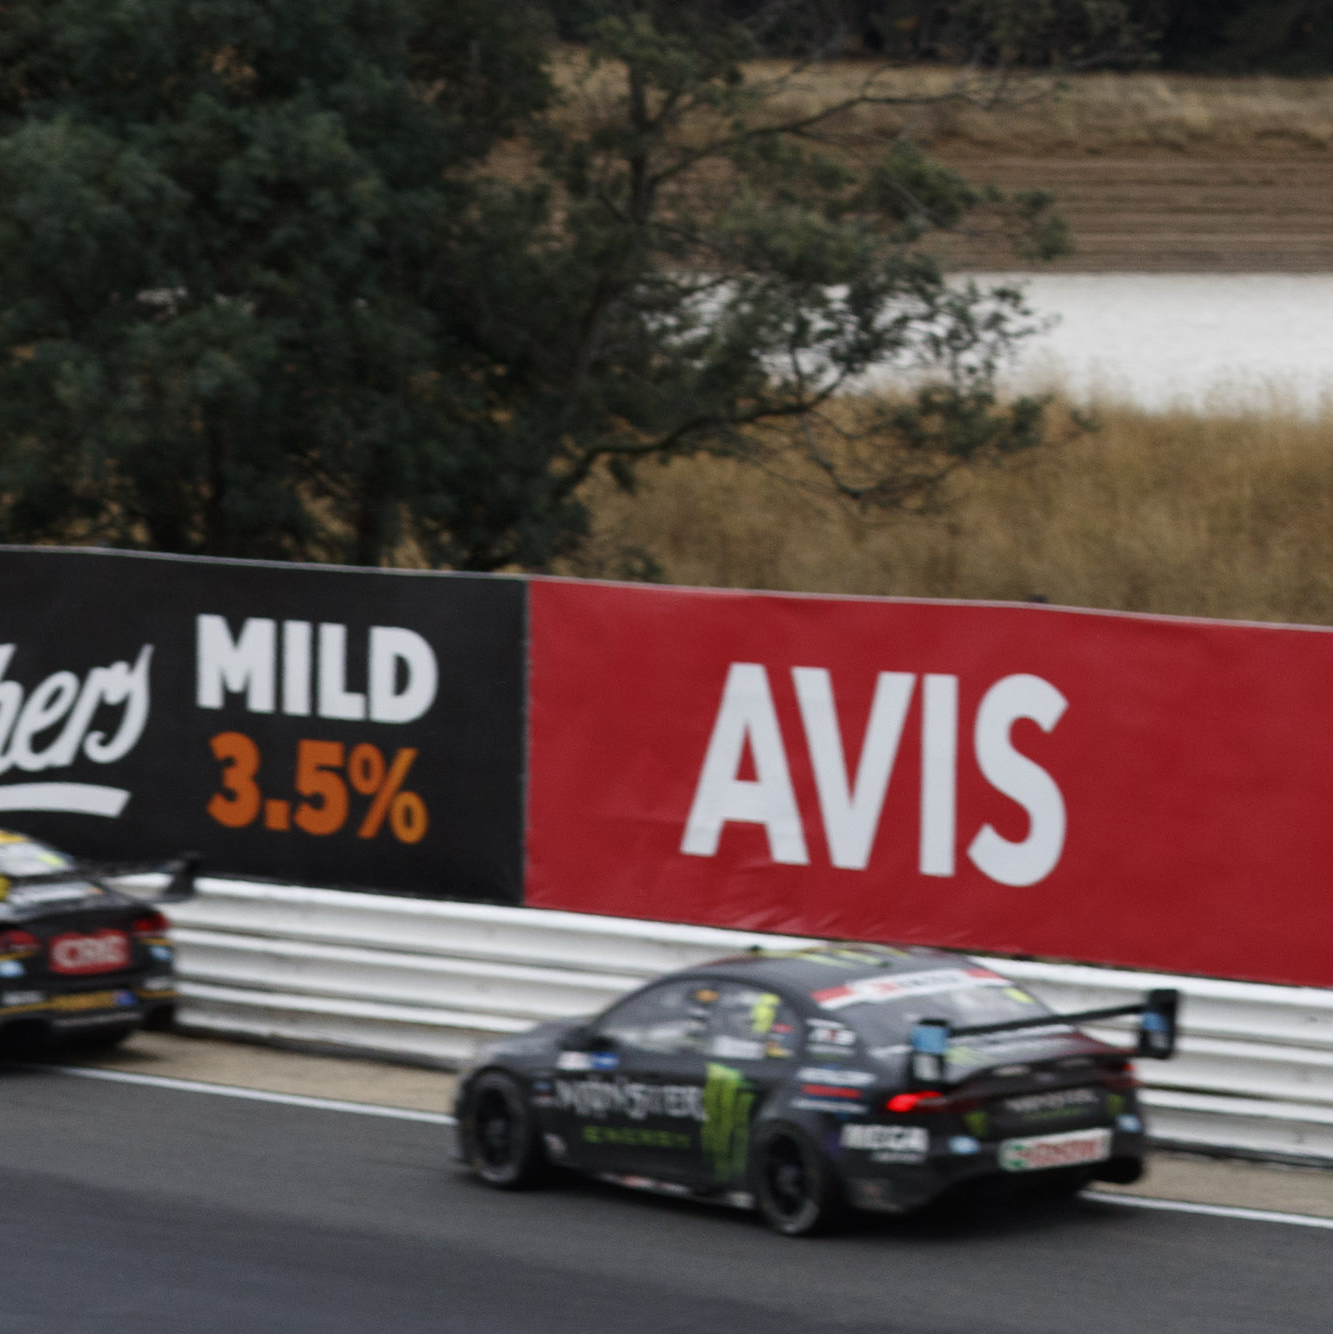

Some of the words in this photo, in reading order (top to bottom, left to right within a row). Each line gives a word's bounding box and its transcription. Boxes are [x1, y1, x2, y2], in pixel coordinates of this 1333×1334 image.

[197, 614, 438, 724] MILD
[208, 732, 428, 843] 3.5%
[680, 661, 1069, 887] AVIS
